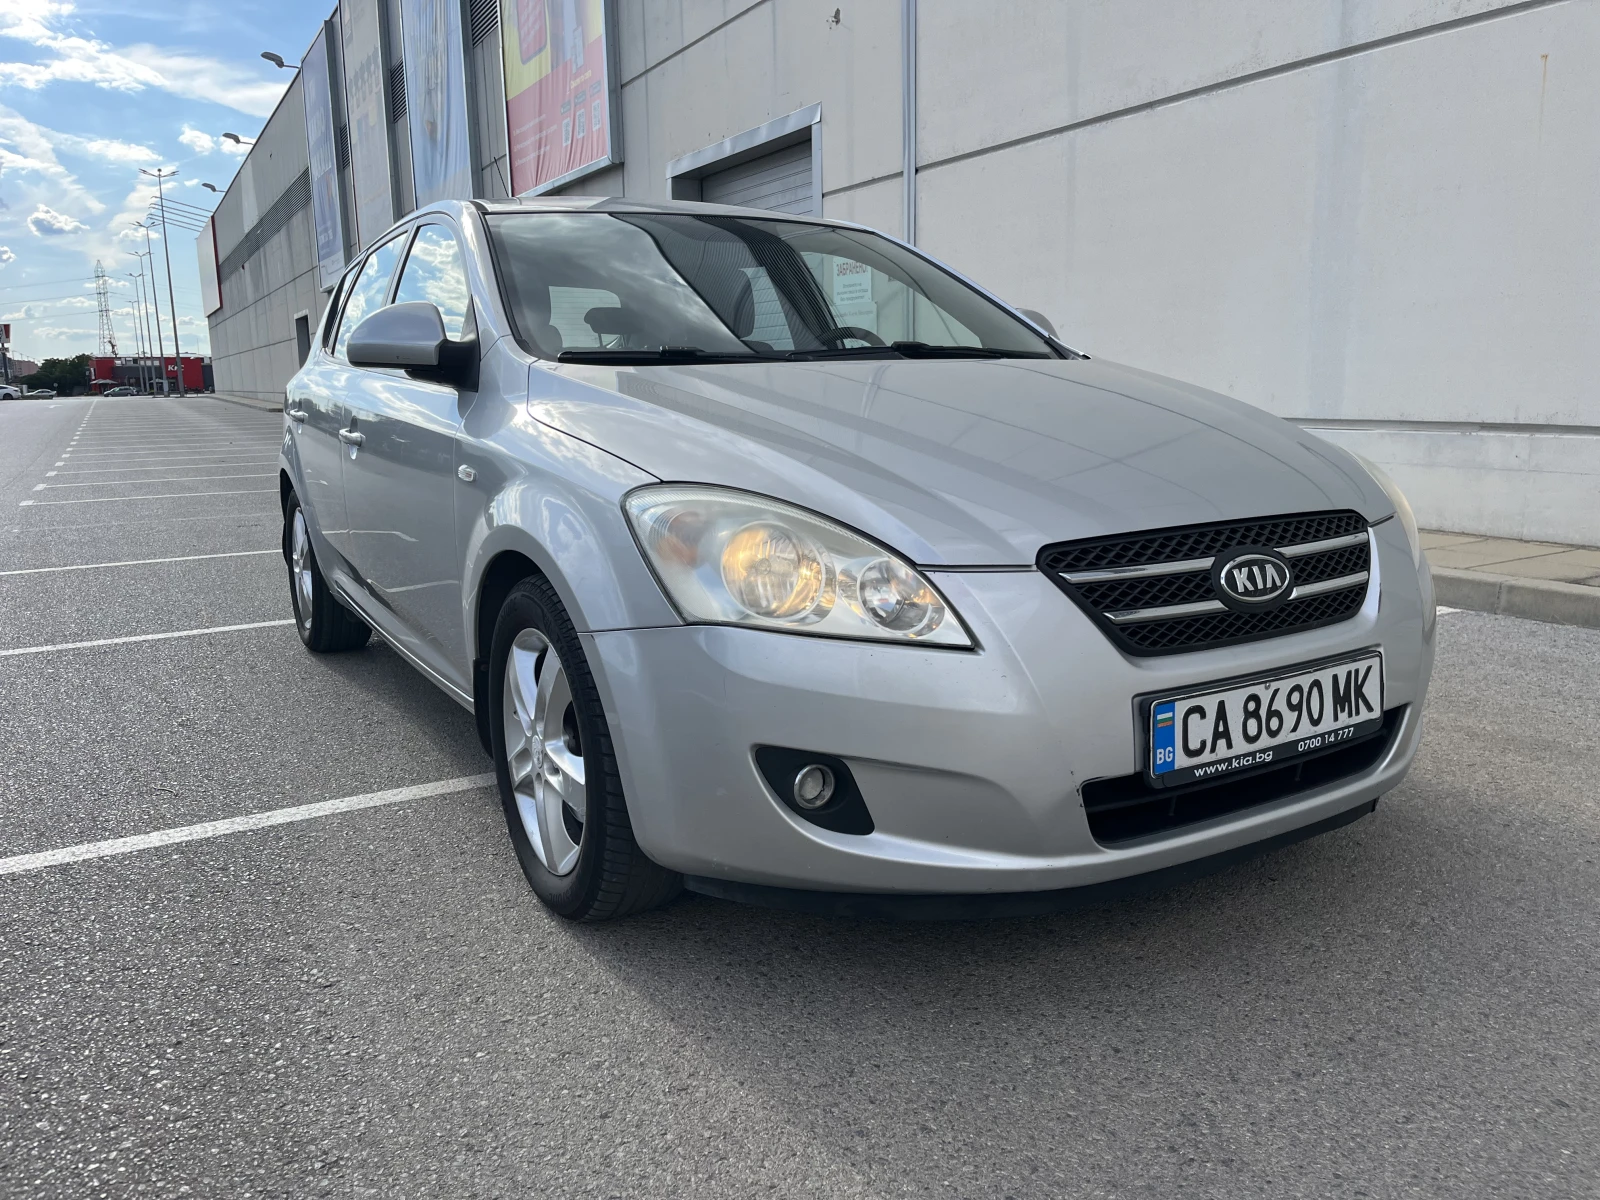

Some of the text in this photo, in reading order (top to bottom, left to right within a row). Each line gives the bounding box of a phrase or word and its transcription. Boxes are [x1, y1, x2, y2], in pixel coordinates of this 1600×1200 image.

[1232, 562, 1282, 593] KIA
[1181, 664, 1375, 759] CA 8690 MK
[1298, 727, 1354, 752] 0700 14 777
[1156, 746, 1174, 765] BG
[1194, 750, 1273, 777] www.kia.bg
